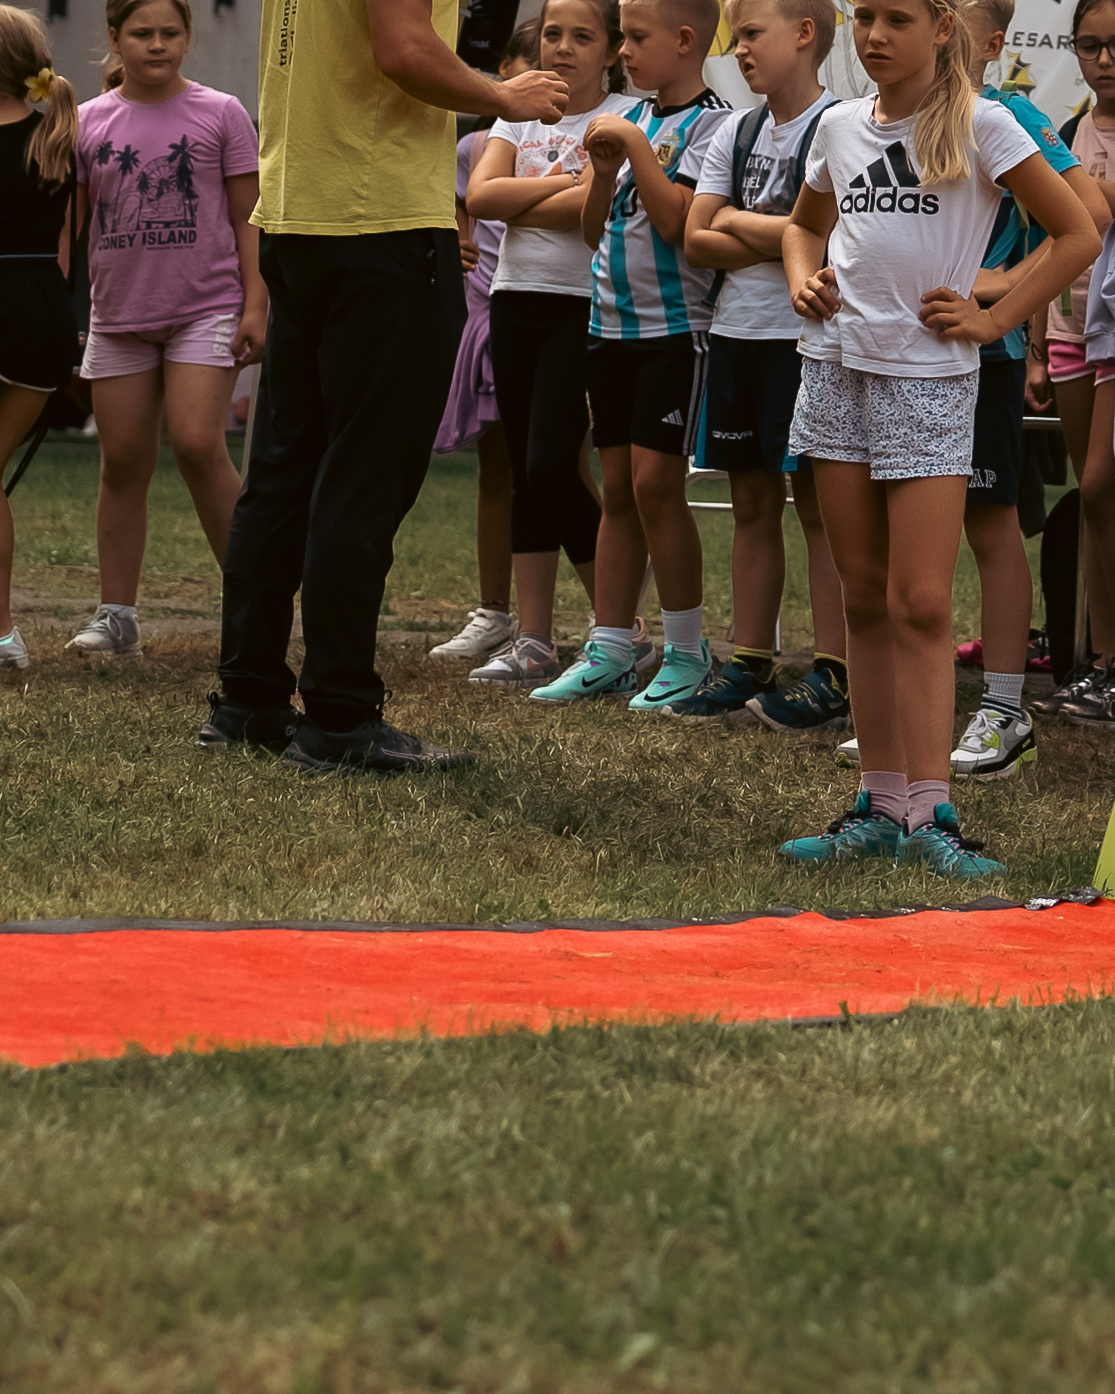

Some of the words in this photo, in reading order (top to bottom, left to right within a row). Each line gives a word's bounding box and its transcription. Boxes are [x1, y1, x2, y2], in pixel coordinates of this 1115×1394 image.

[840, 185, 940, 216] adidas
[141, 229, 197, 246] ISLAND
[968, 468, 997, 489] AP
